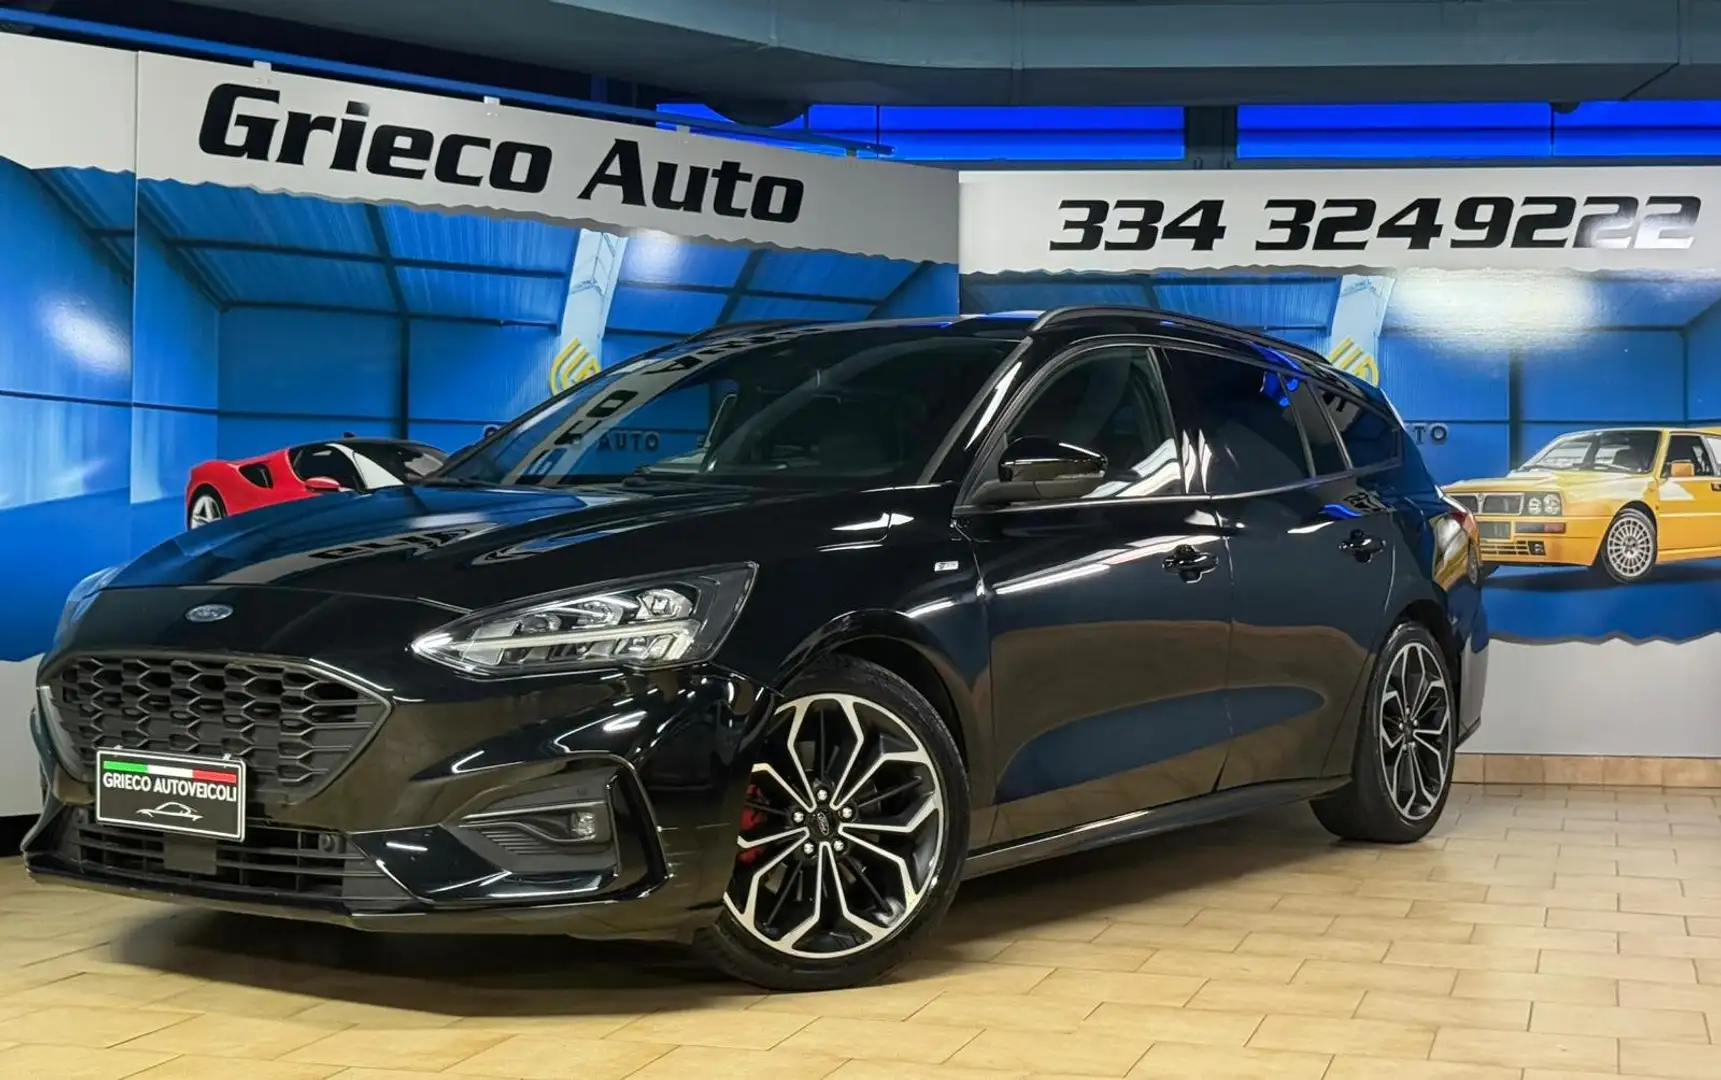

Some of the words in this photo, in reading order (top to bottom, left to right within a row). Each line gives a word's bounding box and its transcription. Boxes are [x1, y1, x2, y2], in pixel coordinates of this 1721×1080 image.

[199, 83, 553, 194] Grieco
[577, 138, 804, 223] Auto
[1050, 199, 1227, 251] 334
[1255, 196, 1702, 251] 3249222
[103, 772, 151, 792] GRIECO
[153, 777, 237, 802] AUTOVEICOLI
